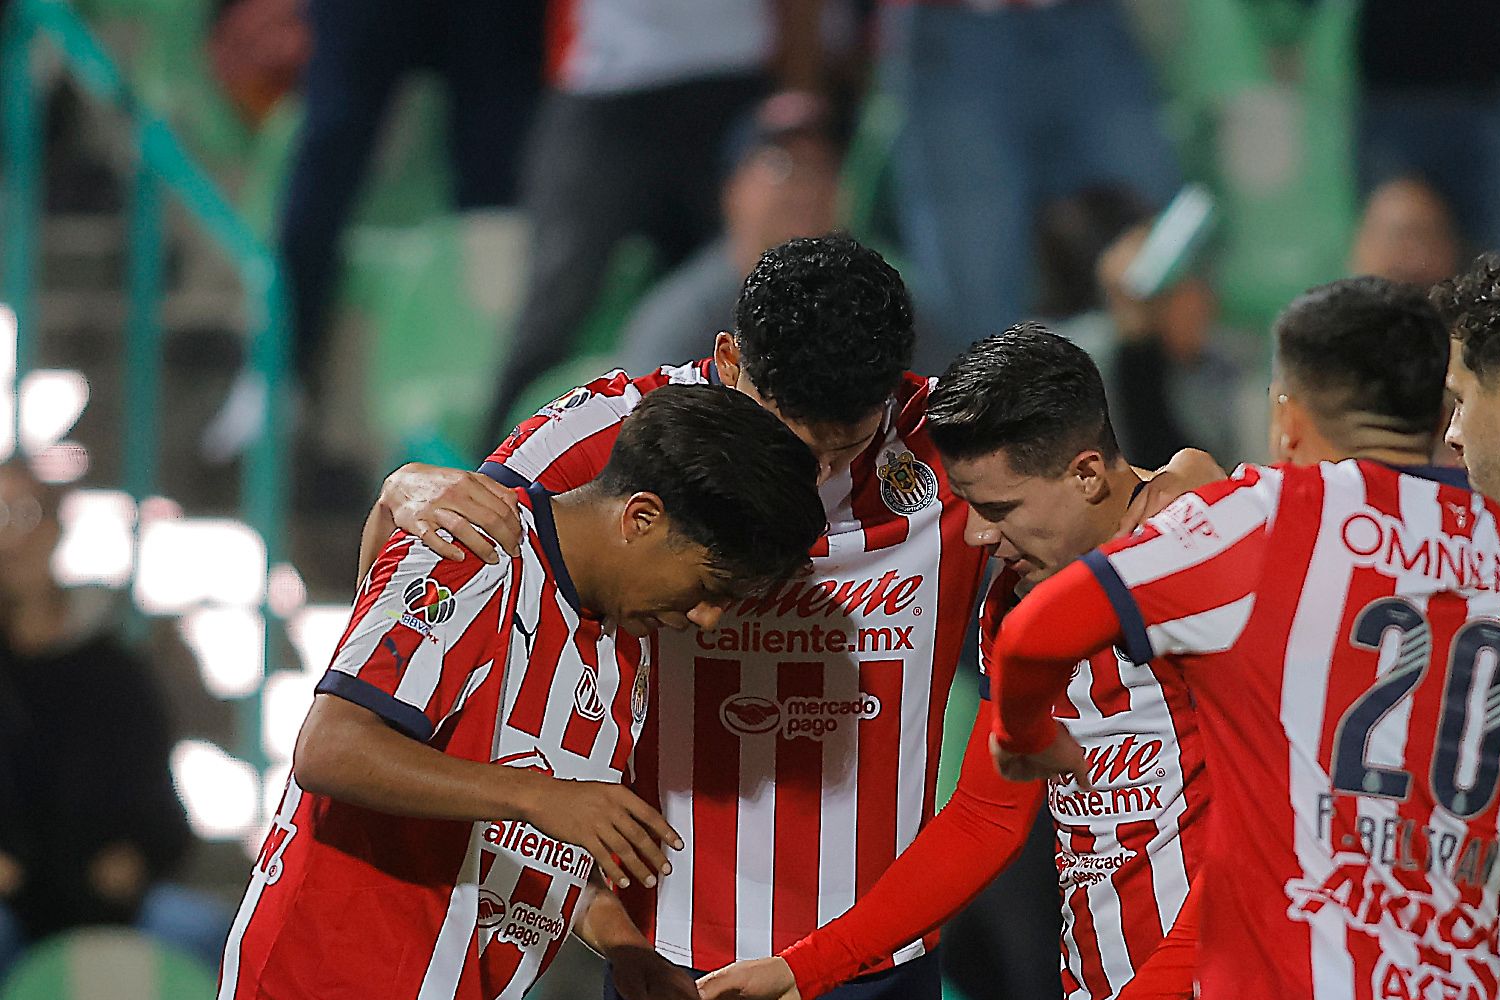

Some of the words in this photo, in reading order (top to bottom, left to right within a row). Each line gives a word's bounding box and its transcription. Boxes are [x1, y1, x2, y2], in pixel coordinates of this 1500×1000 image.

[696, 621, 915, 653] caliente.mx
[787, 697, 876, 716] mercado
[787, 717, 838, 736] pago
[503, 921, 541, 947] pago
[511, 906, 562, 937] mercado
